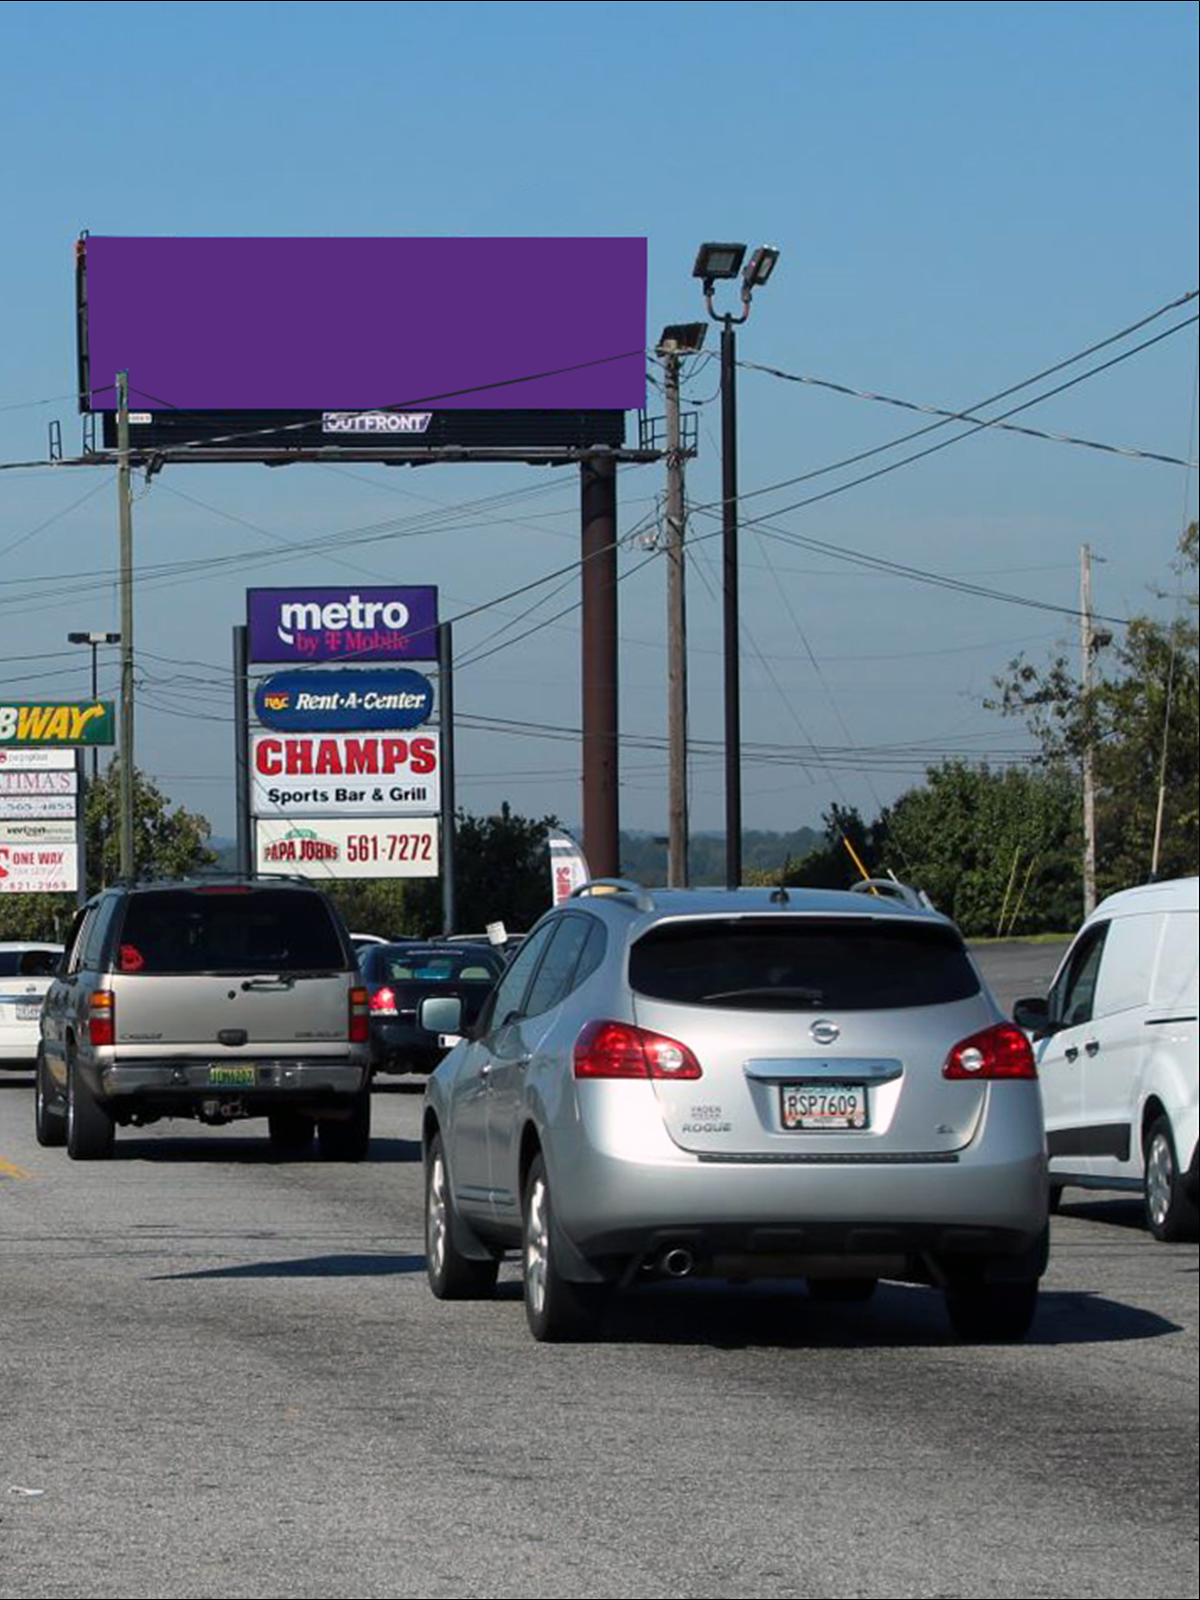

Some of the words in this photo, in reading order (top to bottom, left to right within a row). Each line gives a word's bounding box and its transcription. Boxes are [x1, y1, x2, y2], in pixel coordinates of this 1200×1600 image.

[326, 414, 422, 431] OUTFRONT
[280, 595, 409, 630] metro
[256, 739, 437, 776] CHAMPS
[268, 788, 329, 806] Sports
[335, 788, 366, 802] Bar
[372, 788, 383, 801] &
[389, 787, 427, 801] Grill
[263, 840, 297, 862] PAPA
[347, 834, 432, 862] 561-7272
[13, 852, 35, 866] ONE
[39, 852, 64, 865] WAY
[787, 1095, 858, 1116] RSP7609
[682, 1123, 732, 1133] ROGUE
